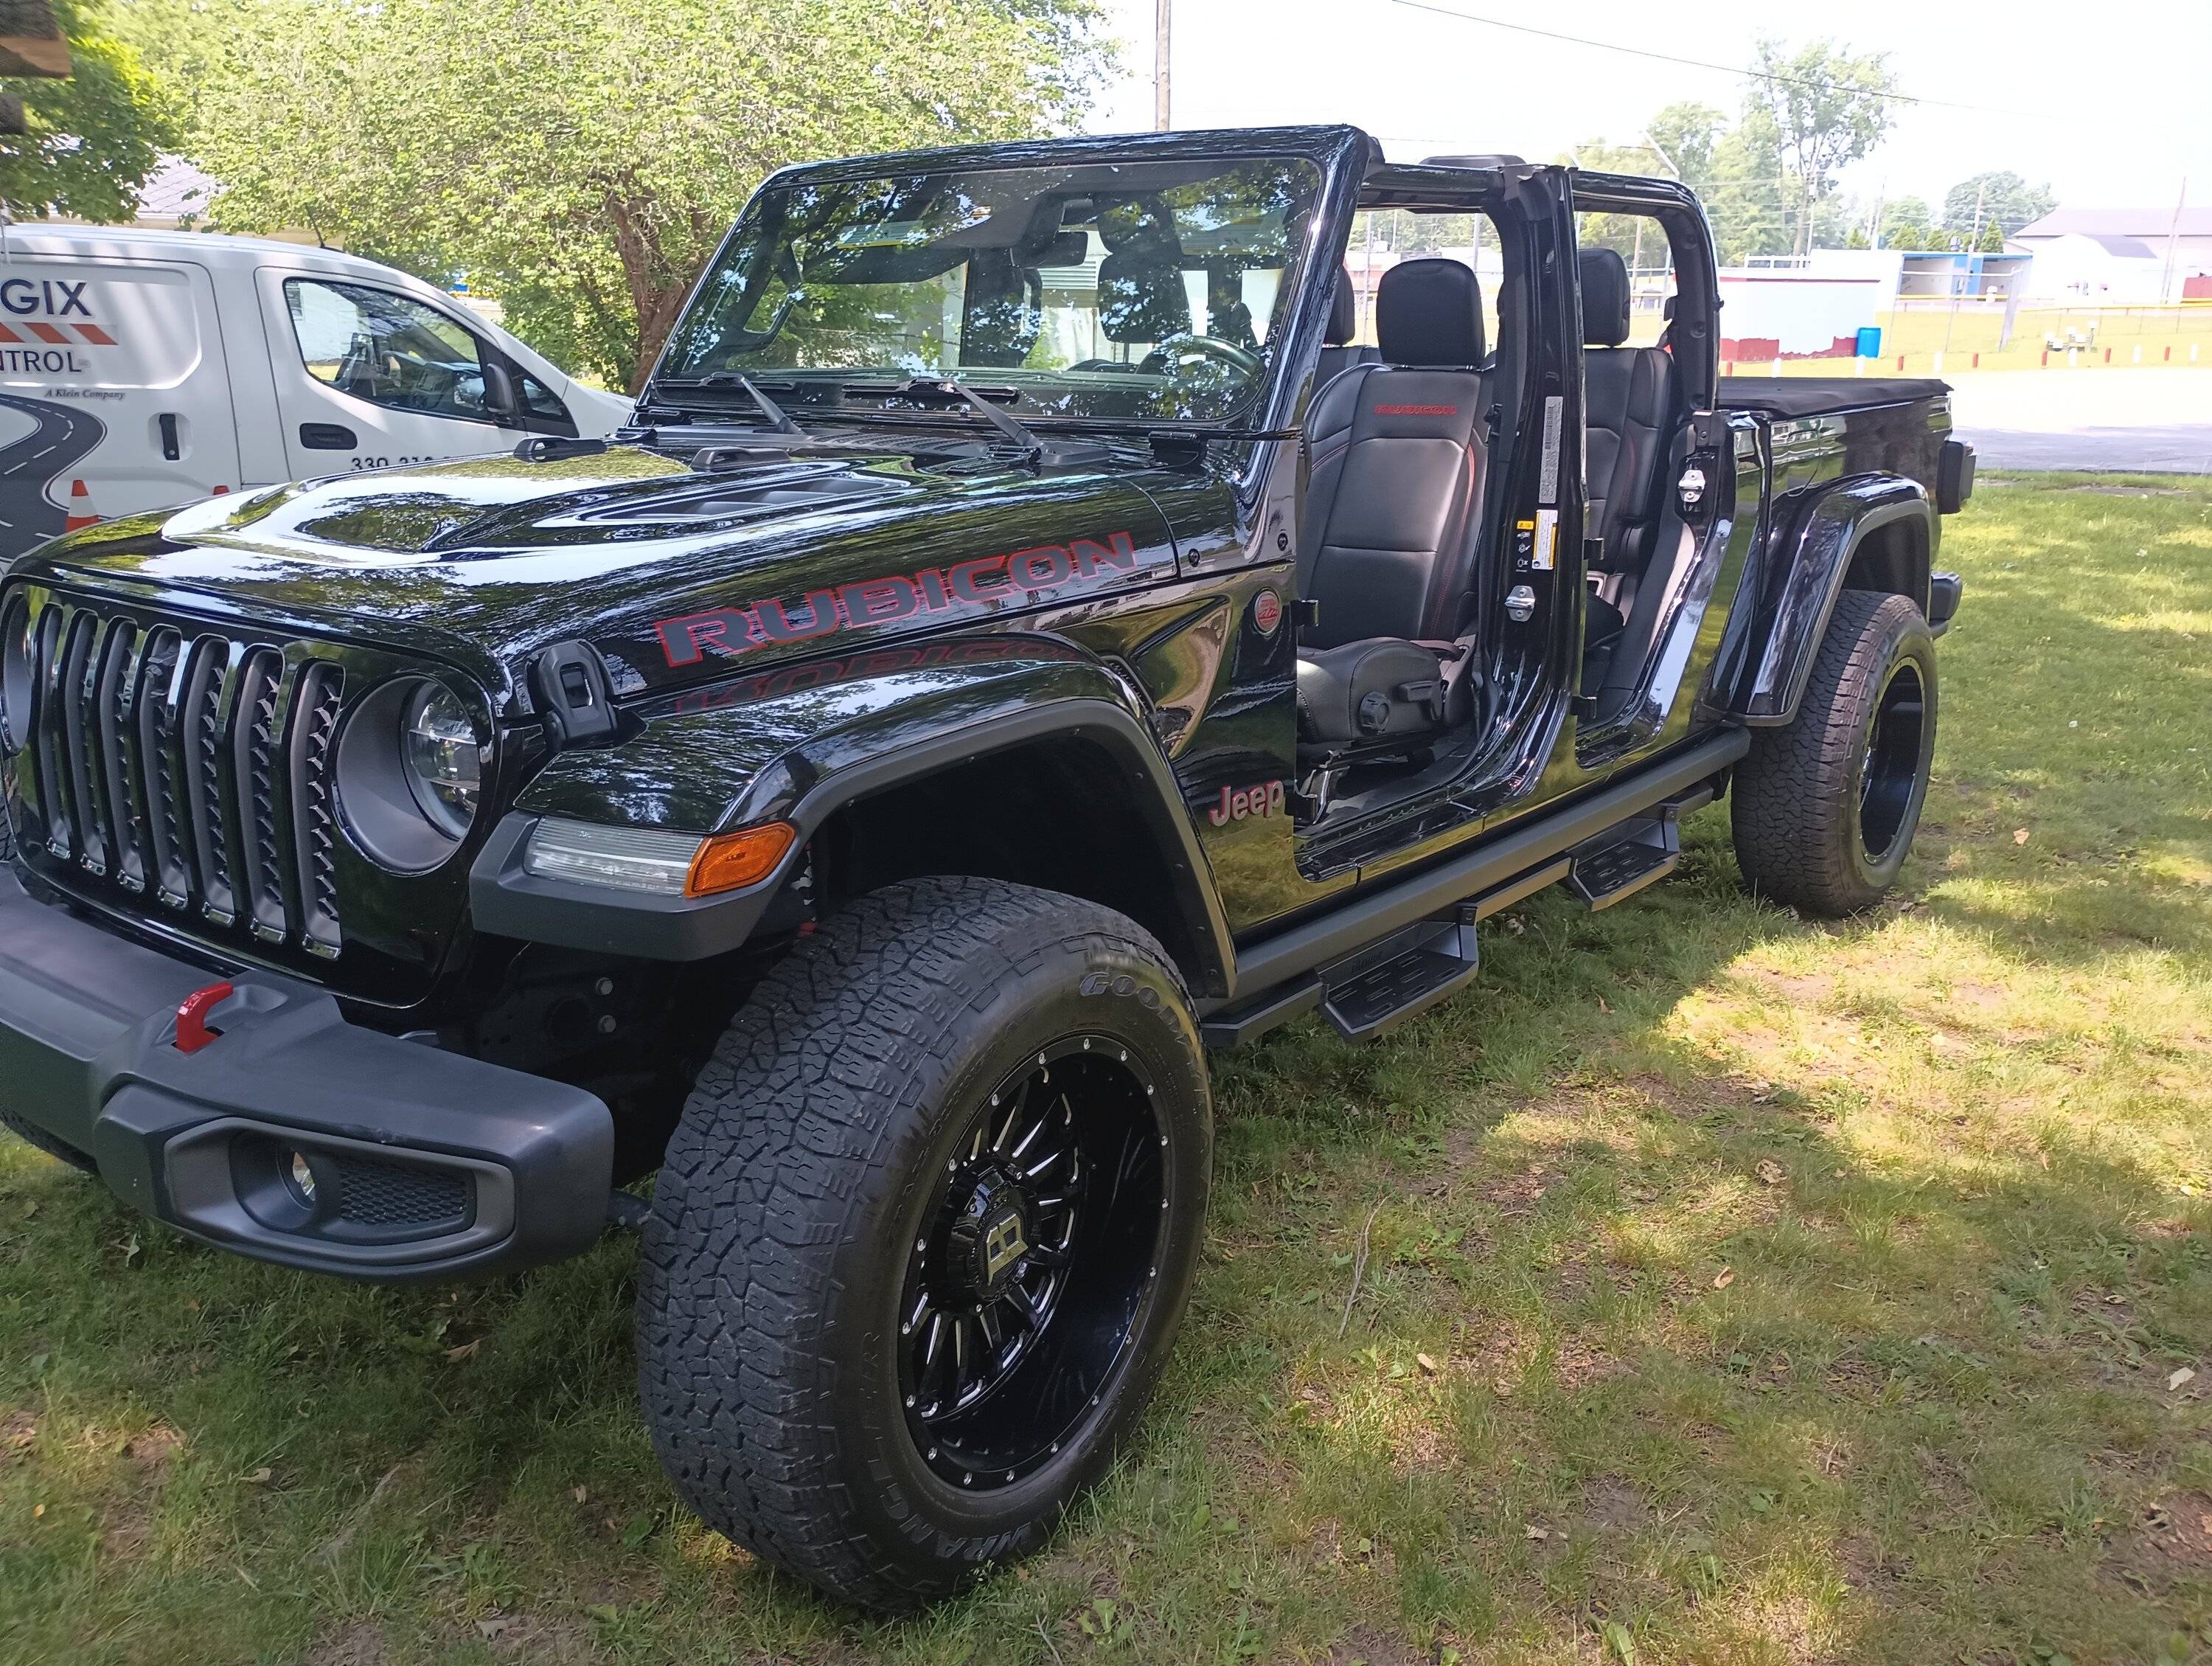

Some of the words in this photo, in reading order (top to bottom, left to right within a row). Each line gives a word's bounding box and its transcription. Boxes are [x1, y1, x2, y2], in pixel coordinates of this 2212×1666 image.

[44, 389, 53, 398] A
[55, 389, 80, 398] Klein
[82, 389, 125, 400] Company
[655, 532, 1139, 667] RUBICON
[1208, 779, 1285, 827] Jeep
